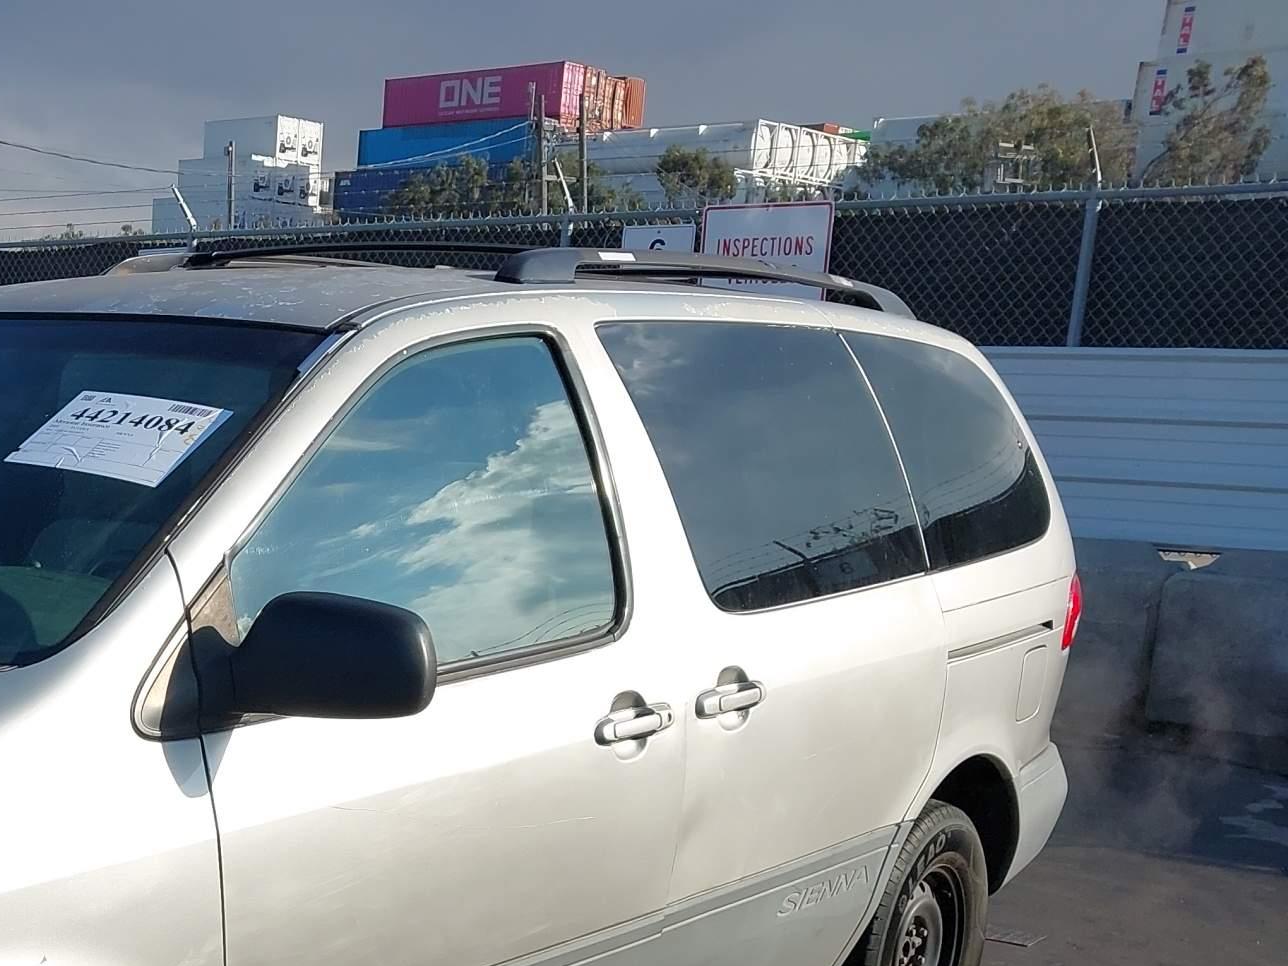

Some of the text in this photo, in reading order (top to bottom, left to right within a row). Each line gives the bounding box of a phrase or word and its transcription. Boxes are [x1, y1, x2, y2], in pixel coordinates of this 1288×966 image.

[439, 76, 502, 109] ONE
[717, 235, 814, 257] INSPECTIONS
[70, 407, 196, 435] 44214084
[777, 865, 869, 917] SIENNA
